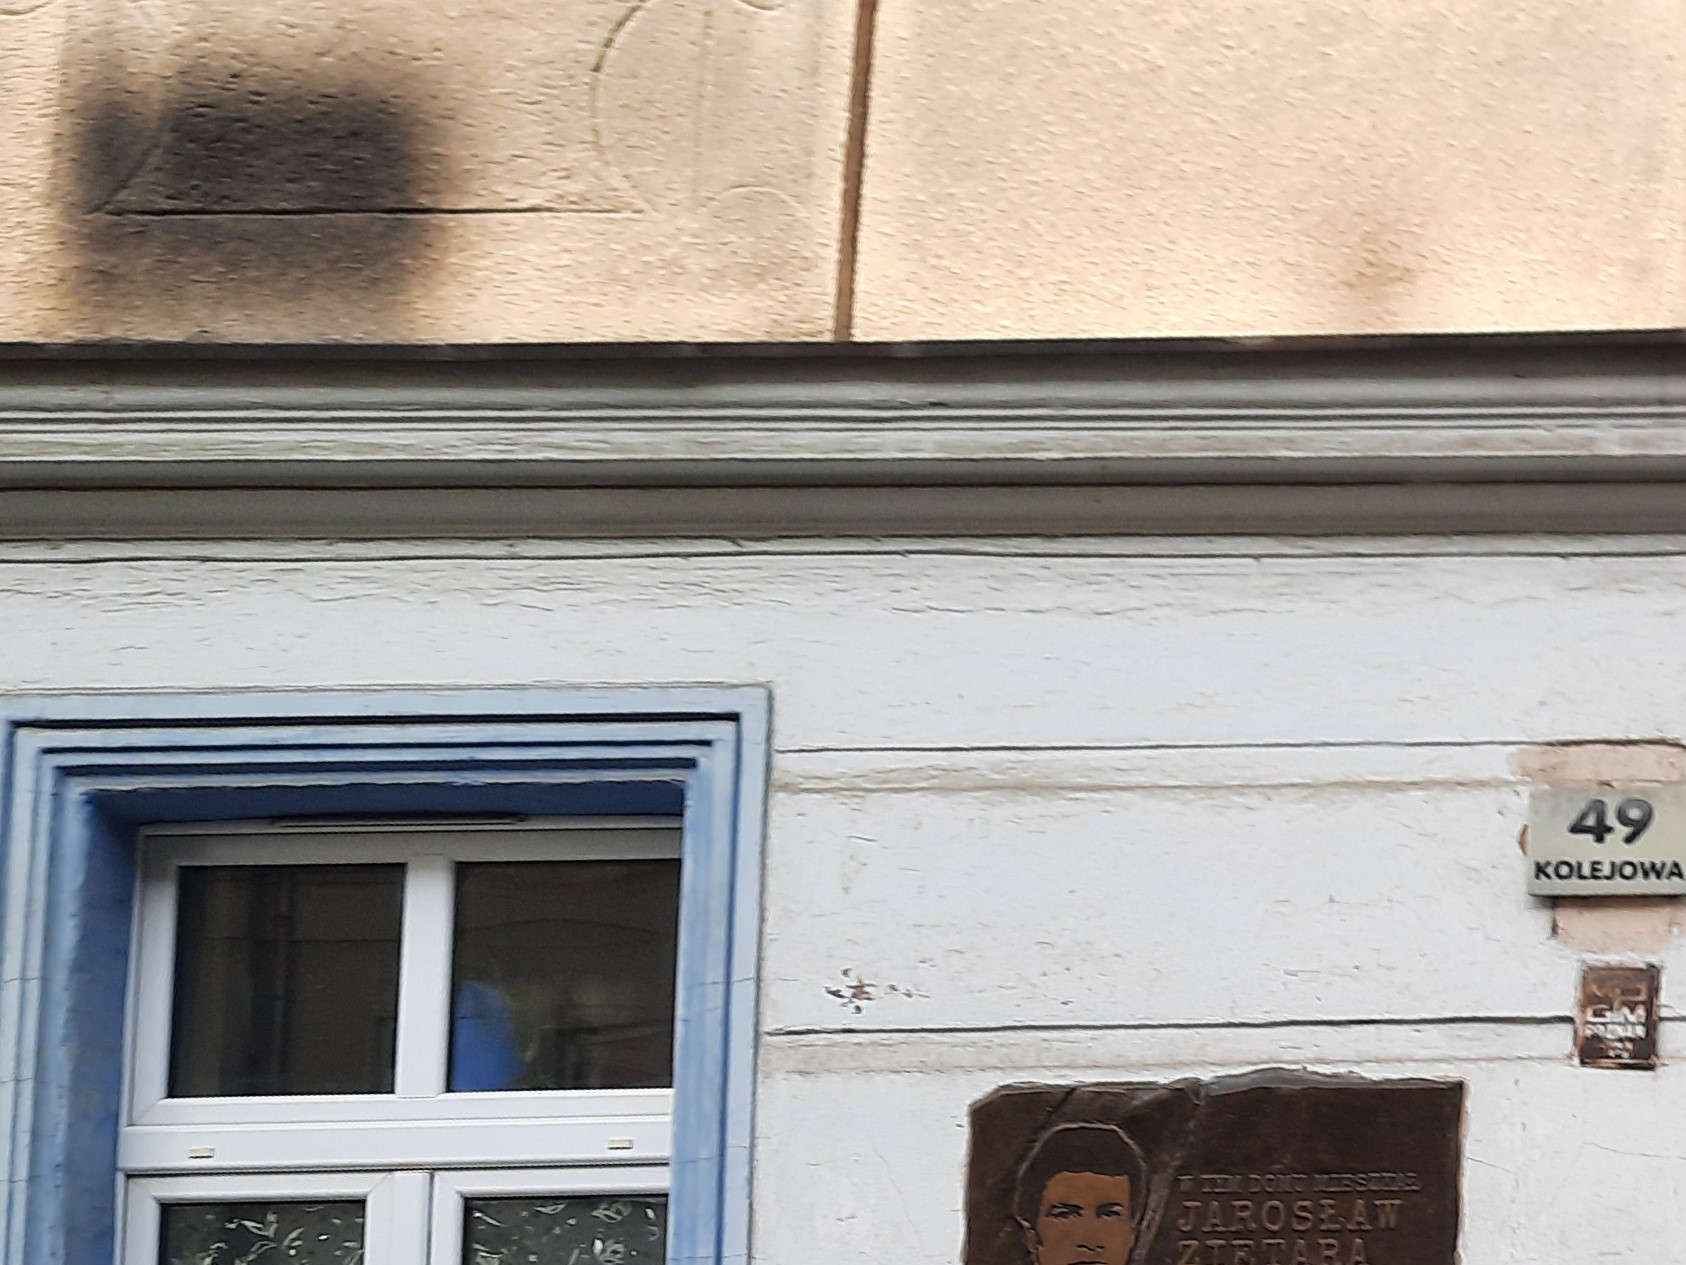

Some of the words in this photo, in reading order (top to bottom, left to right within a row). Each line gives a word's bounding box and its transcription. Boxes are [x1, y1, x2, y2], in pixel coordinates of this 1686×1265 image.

[1568, 798, 1655, 845] 49
[1534, 860, 1686, 881] KOLEJOWA
[1177, 1198, 1405, 1232] JAROSŁAW
